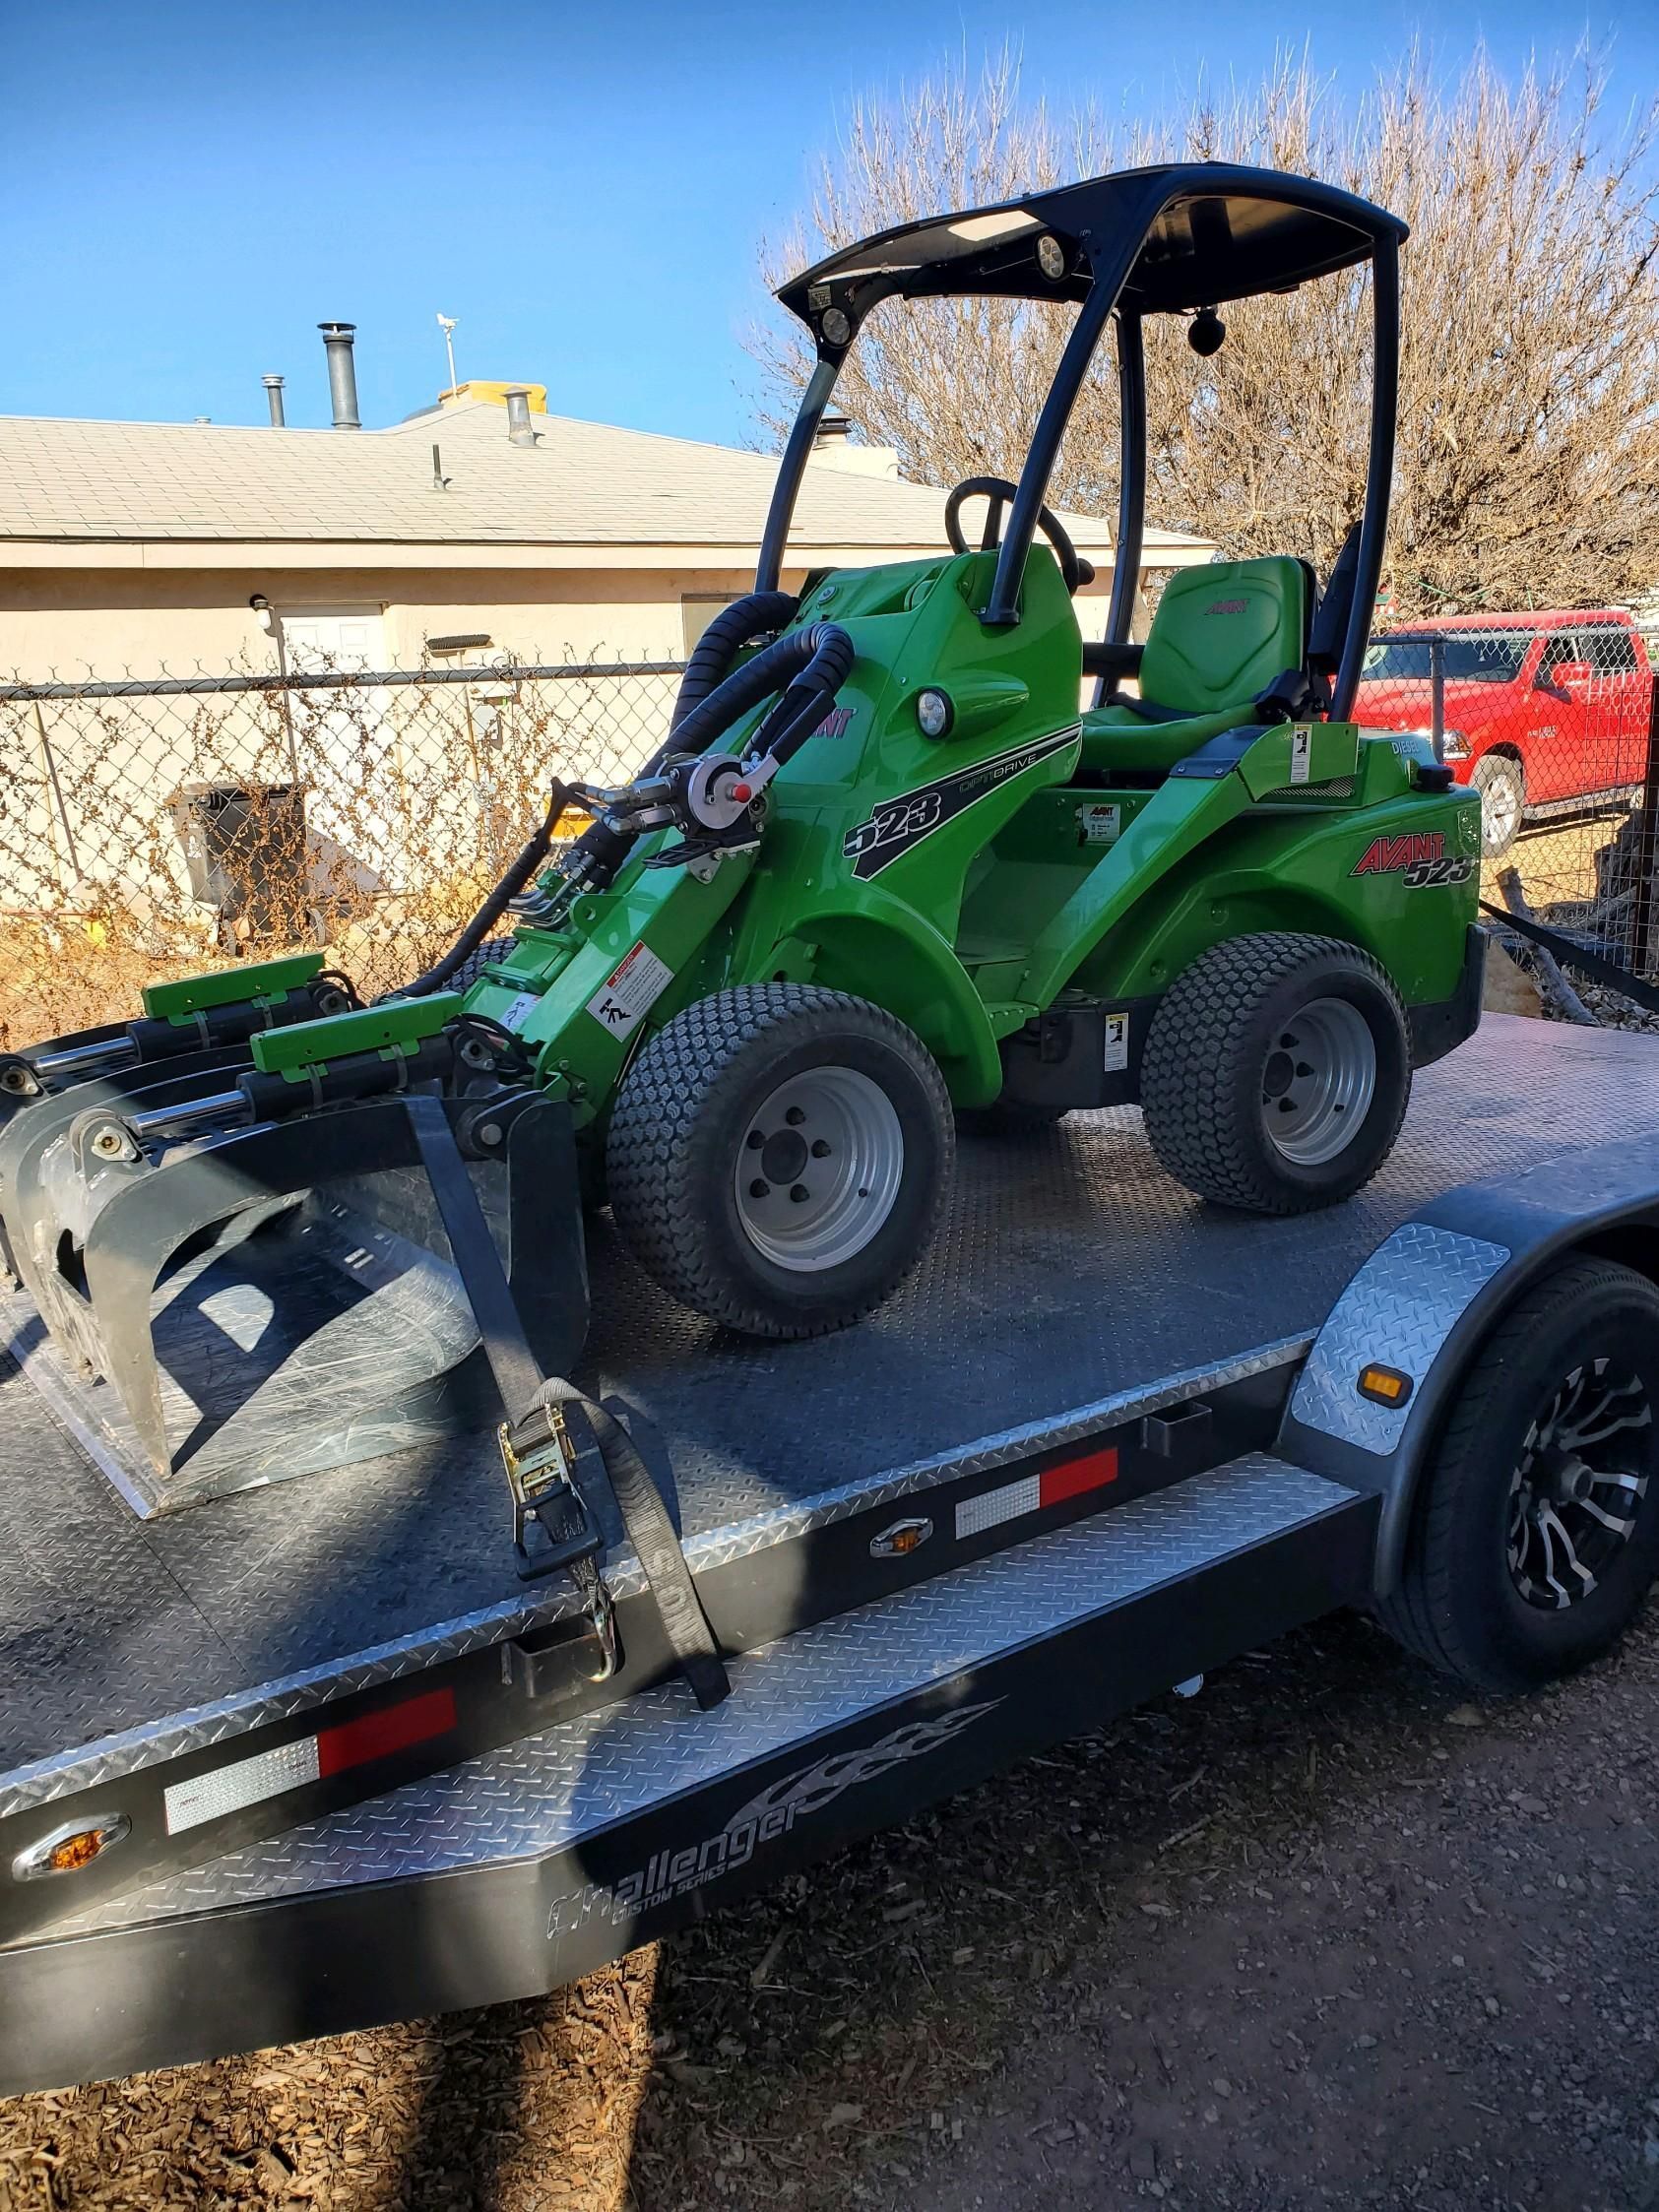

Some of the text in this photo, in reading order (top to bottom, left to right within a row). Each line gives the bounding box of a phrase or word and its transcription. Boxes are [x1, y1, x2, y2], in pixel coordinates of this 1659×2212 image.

[1391, 739, 1420, 755] DIESEL
[842, 792, 941, 858] 523
[1348, 831, 1445, 877] AVANT
[1402, 853, 1476, 889] 523
[611, 1862, 727, 1926] CUSTOM SERIES
